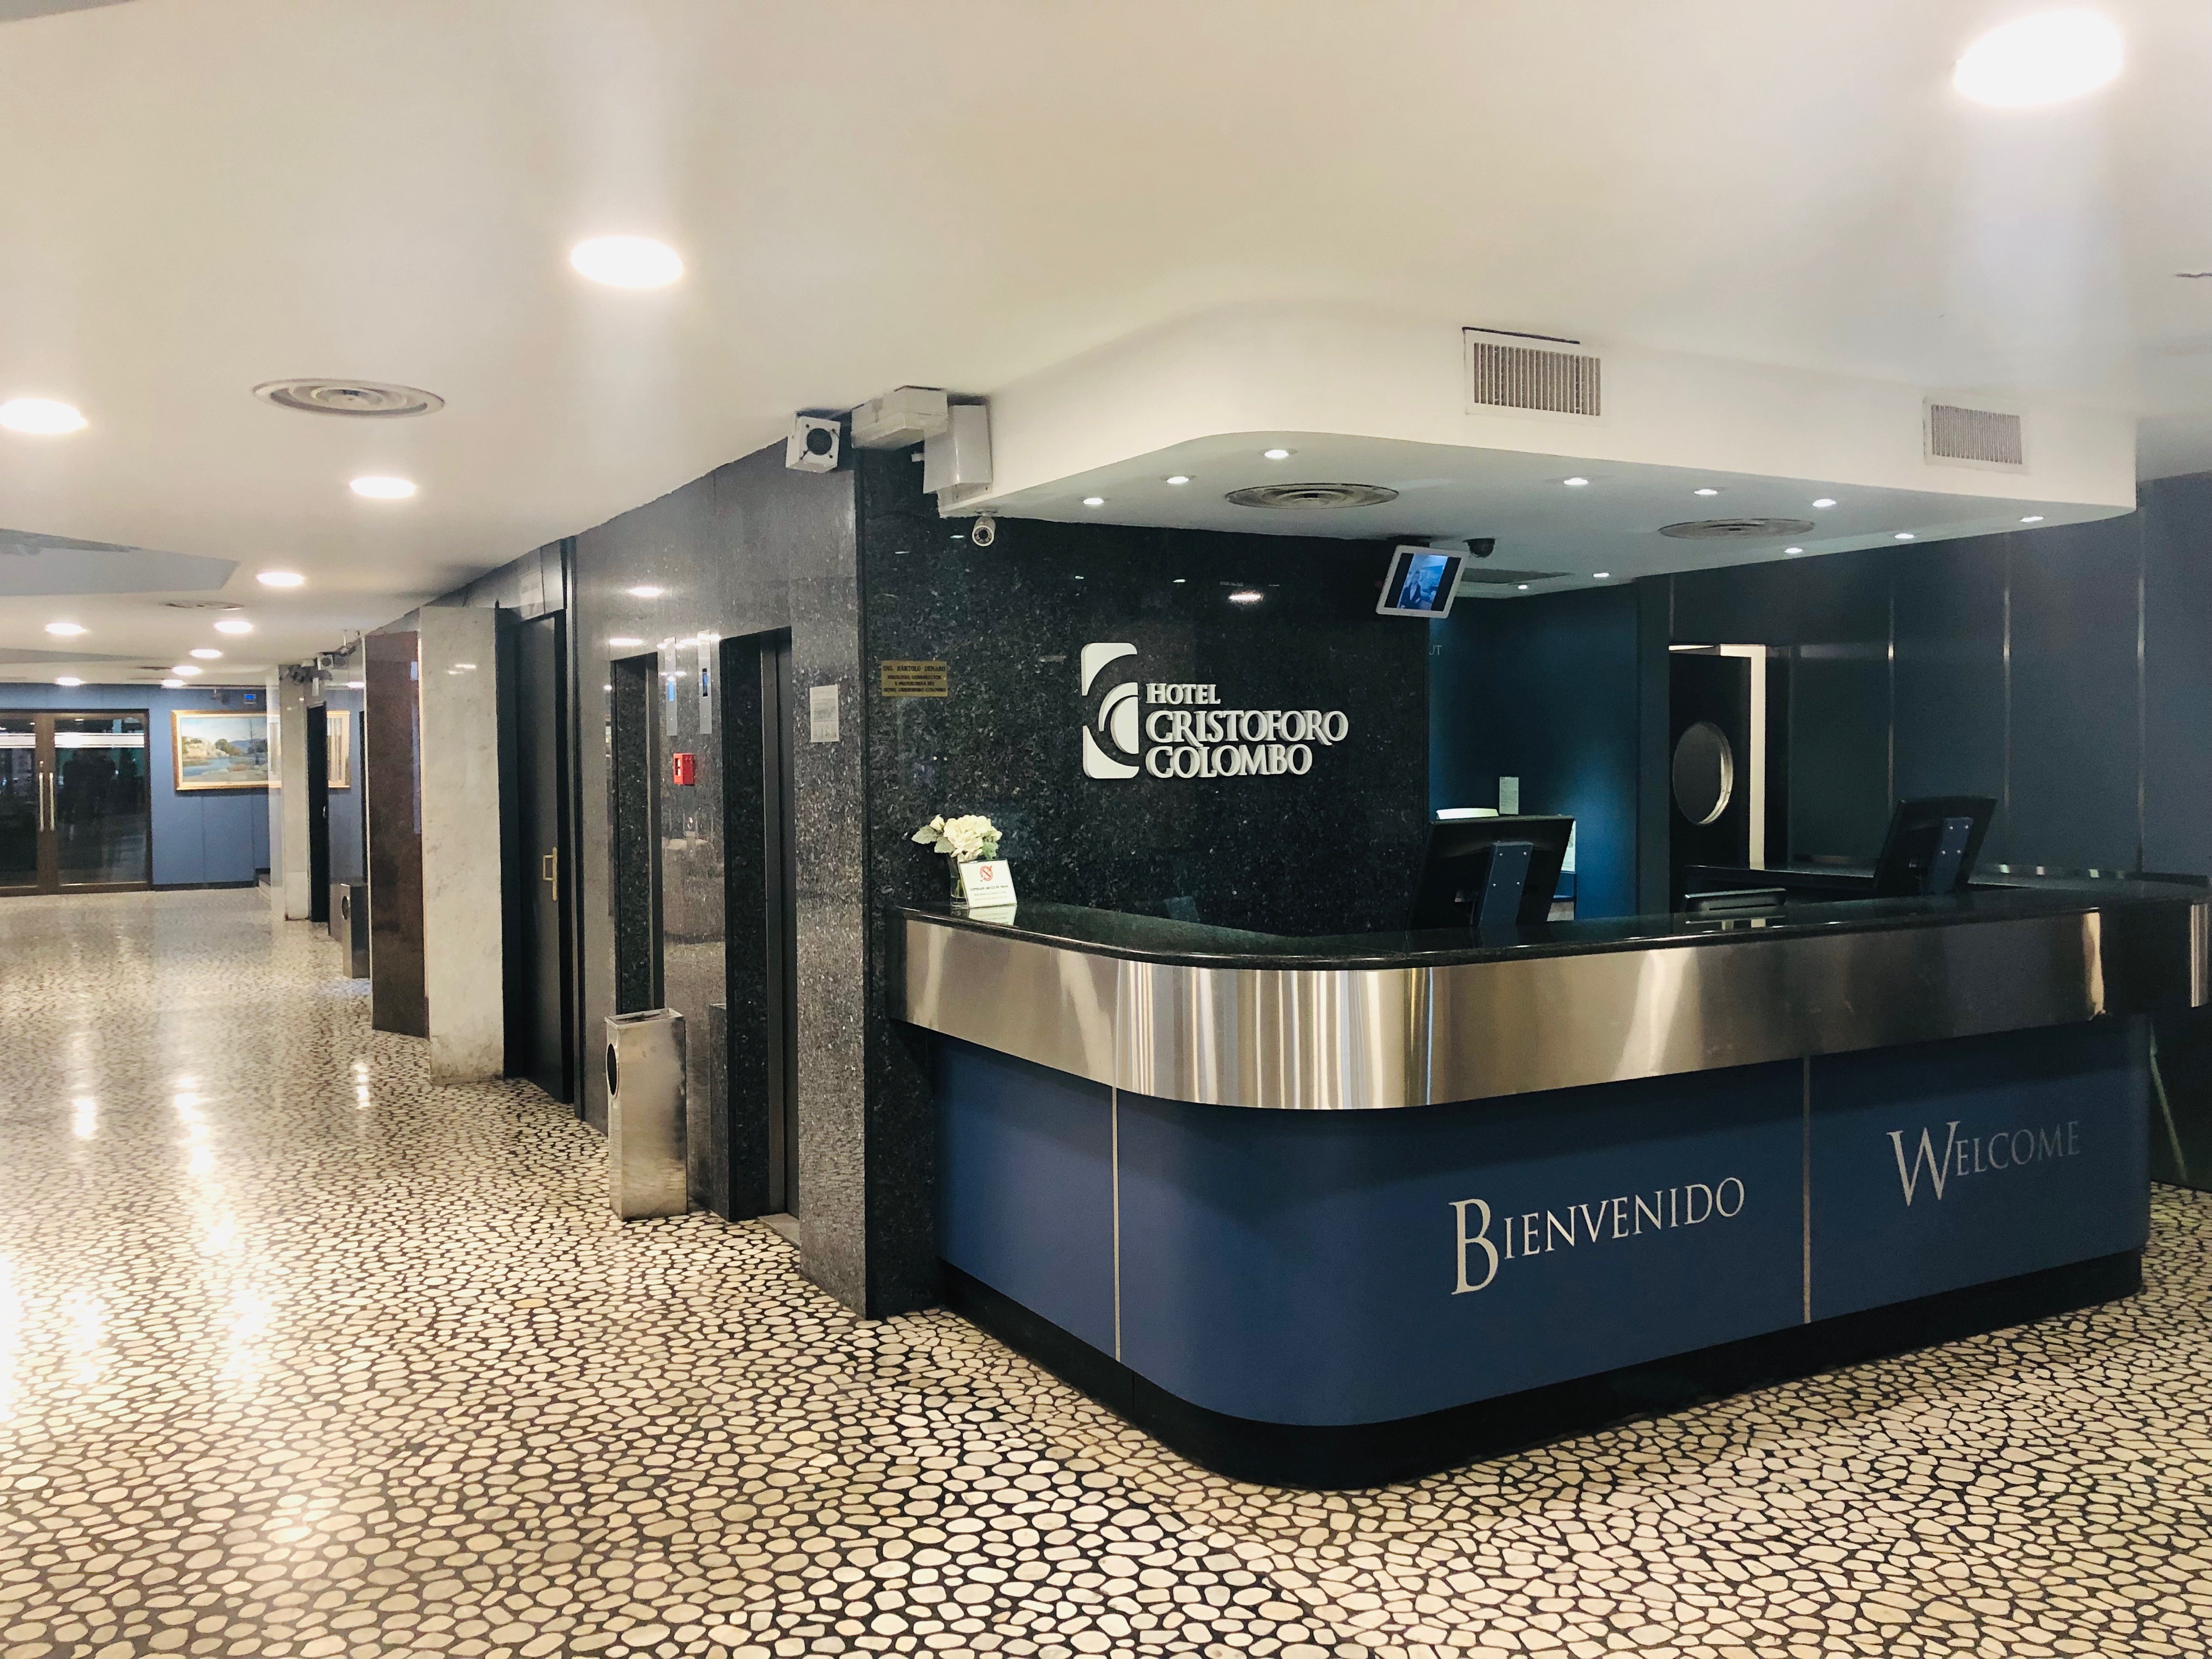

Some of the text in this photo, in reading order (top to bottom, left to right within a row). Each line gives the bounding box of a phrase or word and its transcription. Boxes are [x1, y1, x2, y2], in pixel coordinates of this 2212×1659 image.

[1146, 683, 1221, 704] HOTEL
[1146, 710, 1349, 747] CRISTOFORO
[1146, 744, 1313, 778] COLOMBO
[1886, 1121, 2081, 1207] WELCOME
[1448, 1177, 1745, 1295] BIENVENIDO
